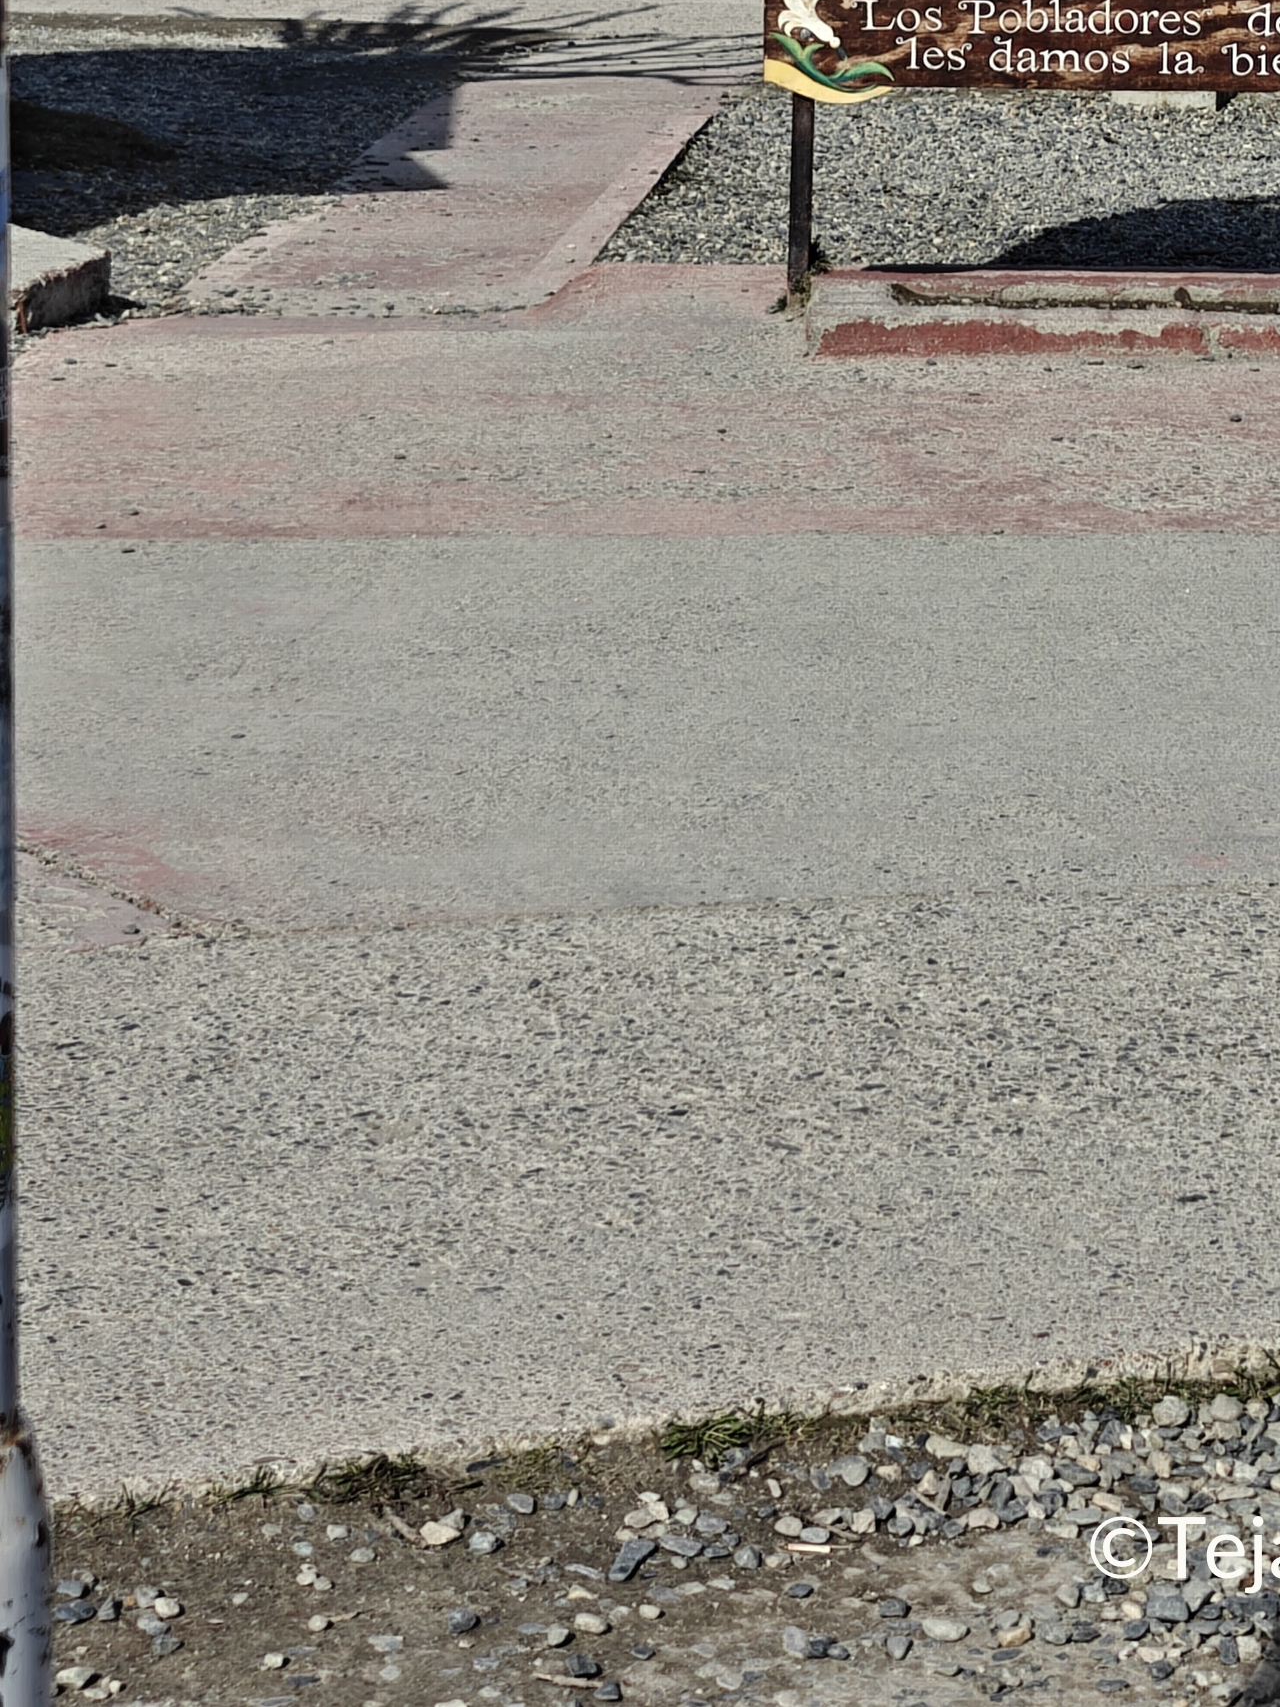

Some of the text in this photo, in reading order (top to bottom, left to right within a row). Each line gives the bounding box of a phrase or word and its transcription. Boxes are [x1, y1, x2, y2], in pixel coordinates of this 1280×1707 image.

[895, 36, 972, 71] les
[988, 36, 1134, 75] damos
[1157, 41, 1205, 75] la
